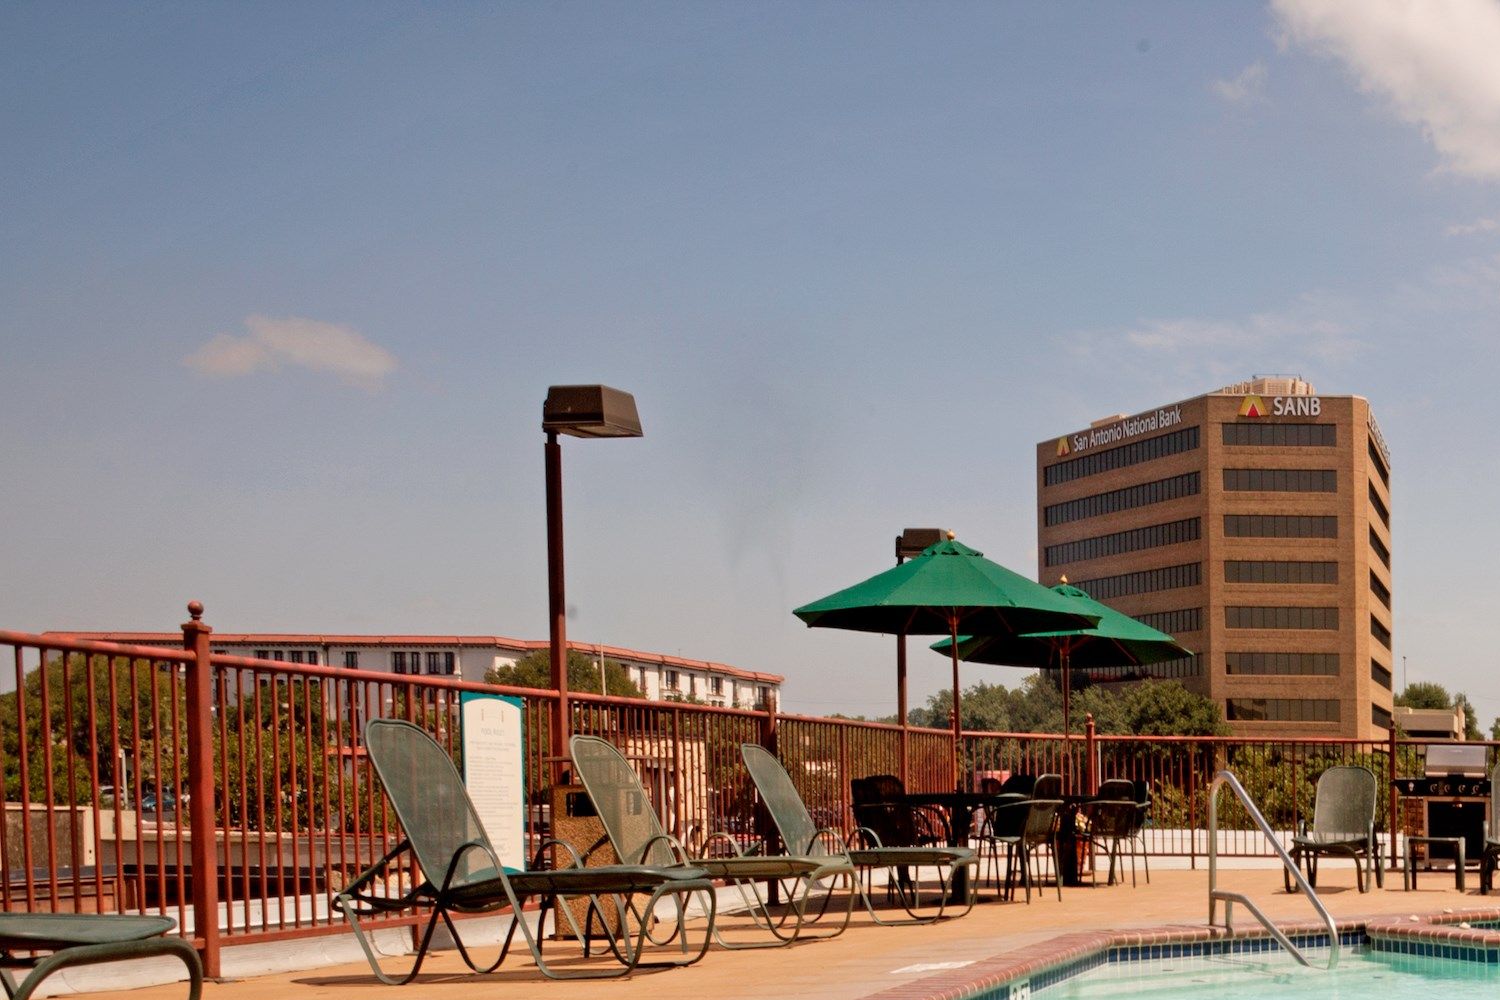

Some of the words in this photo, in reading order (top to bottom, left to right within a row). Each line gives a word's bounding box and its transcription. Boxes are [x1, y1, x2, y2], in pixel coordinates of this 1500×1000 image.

[1273, 397, 1321, 416] SANB
[1074, 434, 1089, 452] San
[1089, 424, 1122, 448] Antonio
[1122, 410, 1159, 438] National
[1159, 404, 1182, 428] Bank
